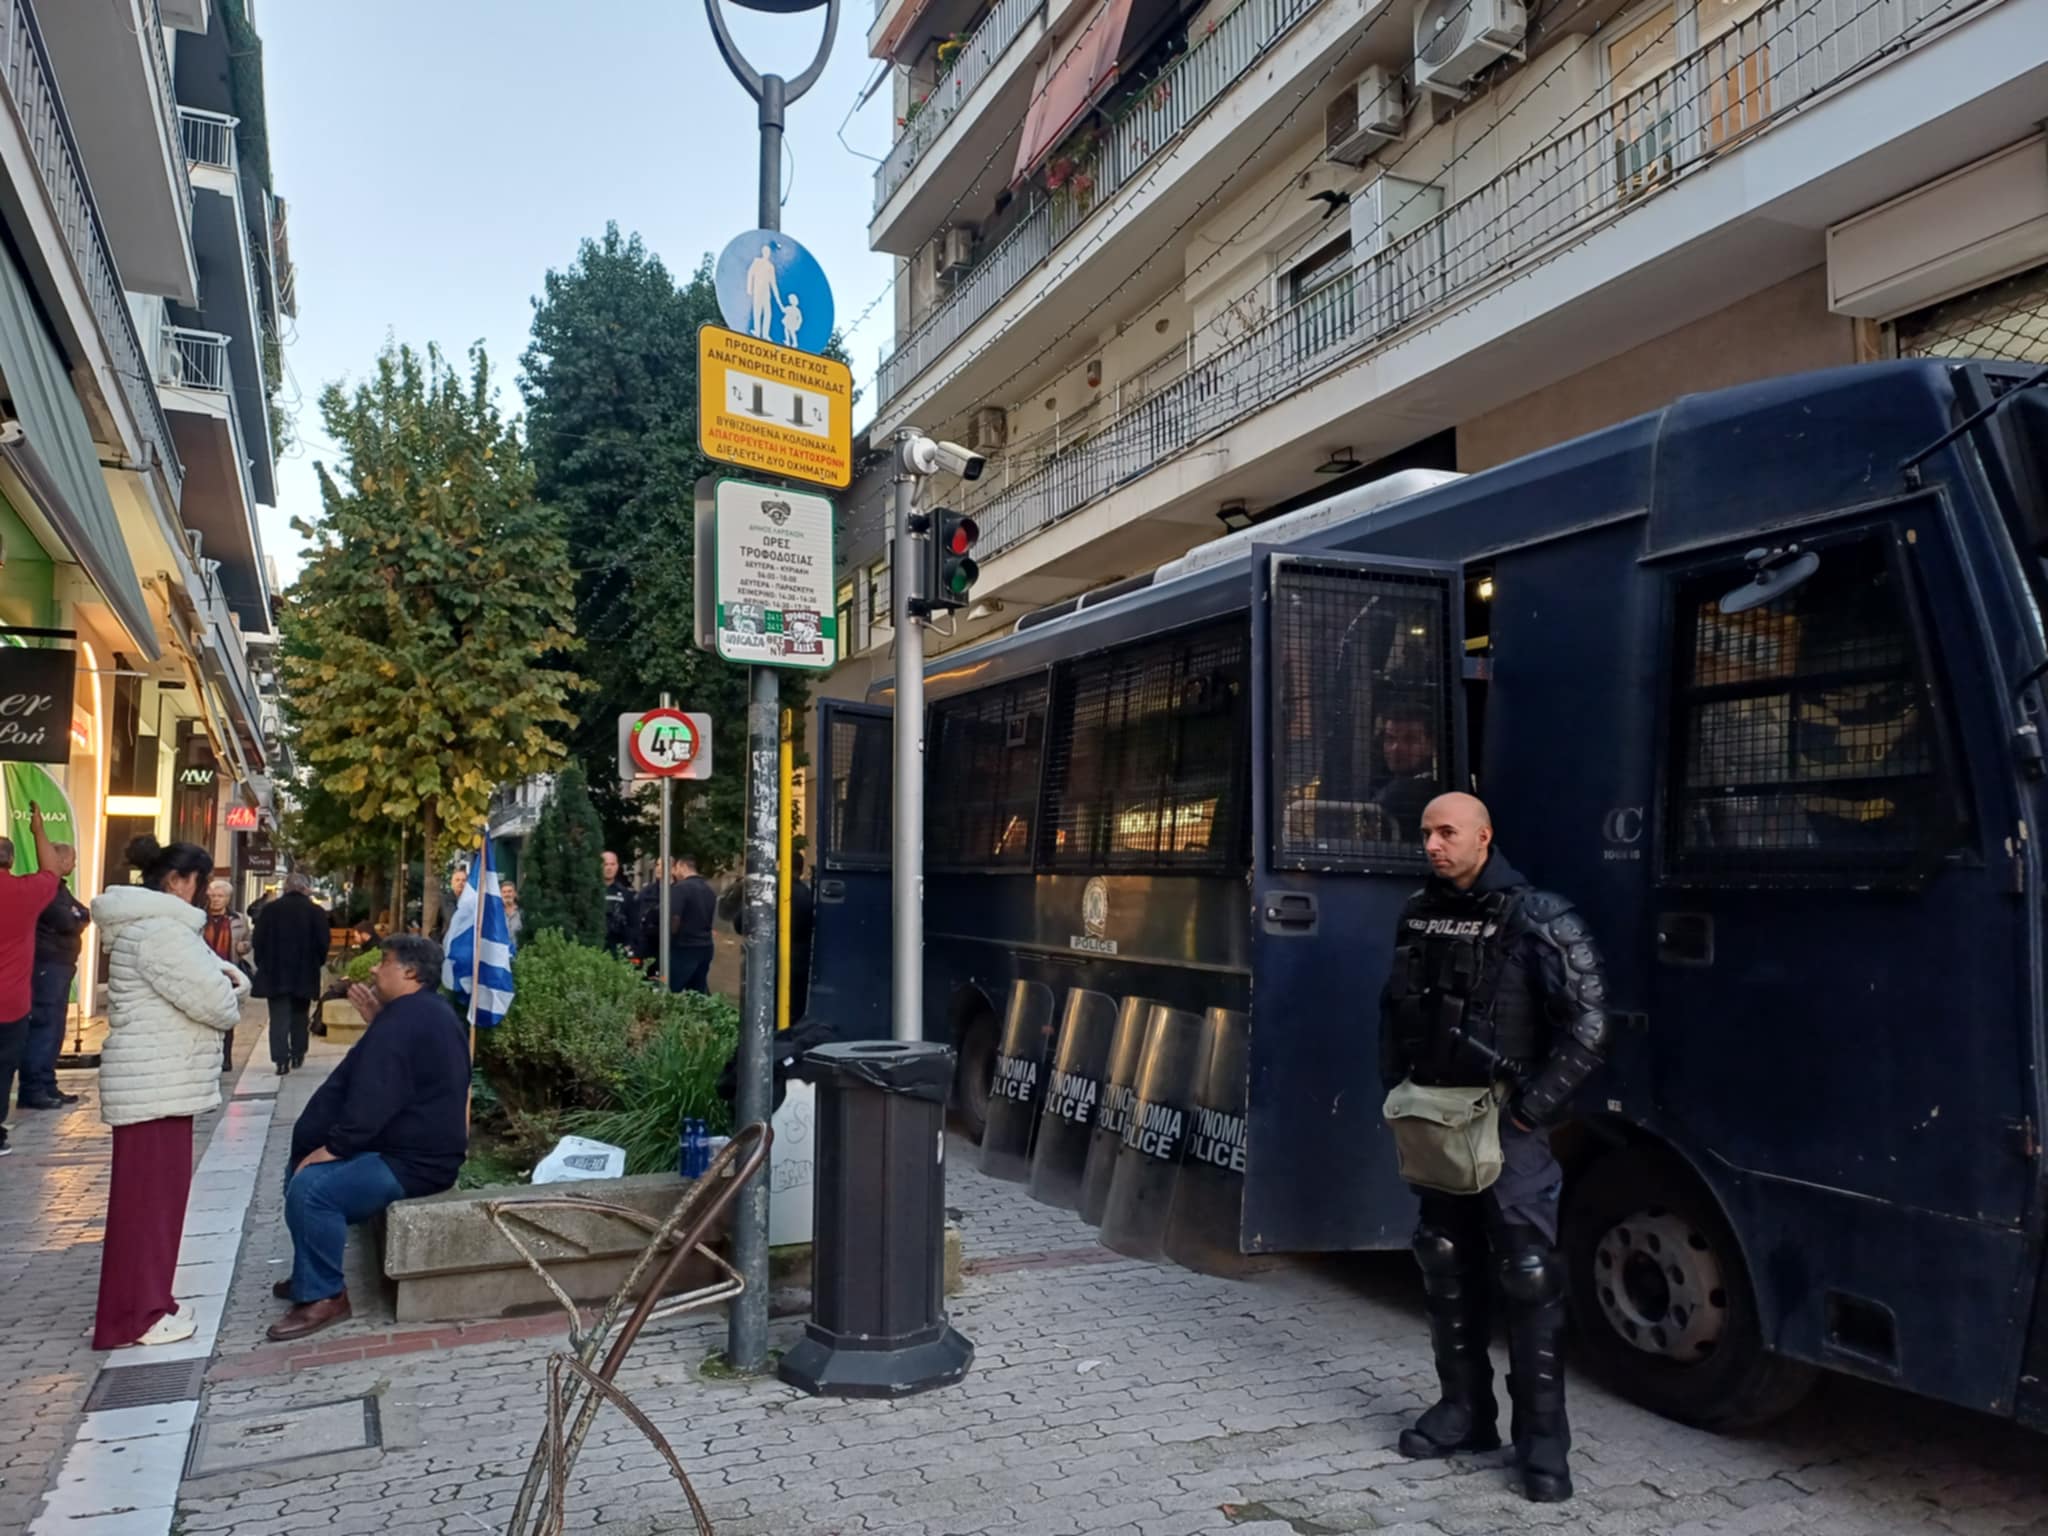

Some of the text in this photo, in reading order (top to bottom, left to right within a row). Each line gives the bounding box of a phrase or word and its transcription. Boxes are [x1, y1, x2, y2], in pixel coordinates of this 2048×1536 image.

[725, 337, 828, 375] ΠΡΟΣΟΧΗ ΕΛΕΓΧΟΣ
[707, 348, 845, 394] ΑΝΑΓΝΩΡΙΣΗΣ ΠΙΝΑΚΙΔΑΣ
[709, 428, 777, 452] ΑΠΑΓΟΡΕΥΕΤΑΙ
[780, 445, 789, 454] Η
[716, 415, 837, 453] ΒΥΘΙΖΟΜΕΝΑ ΚΟΛΩΝΑΚΙΑ
[716, 444, 838, 480] ΔΙΕΛΕΥΣΗ ΔΥΟ ΟΧΗΜΑΤΩΝ
[763, 536, 791, 549] ΩΡΕΣ
[739, 546, 813, 566] ΤΡΟΦΟΔΟΣΙΑΣ
[731, 604, 759, 618] AEL
[1425, 919, 1482, 936] POLICE
[1074, 937, 1113, 952] POLICE
